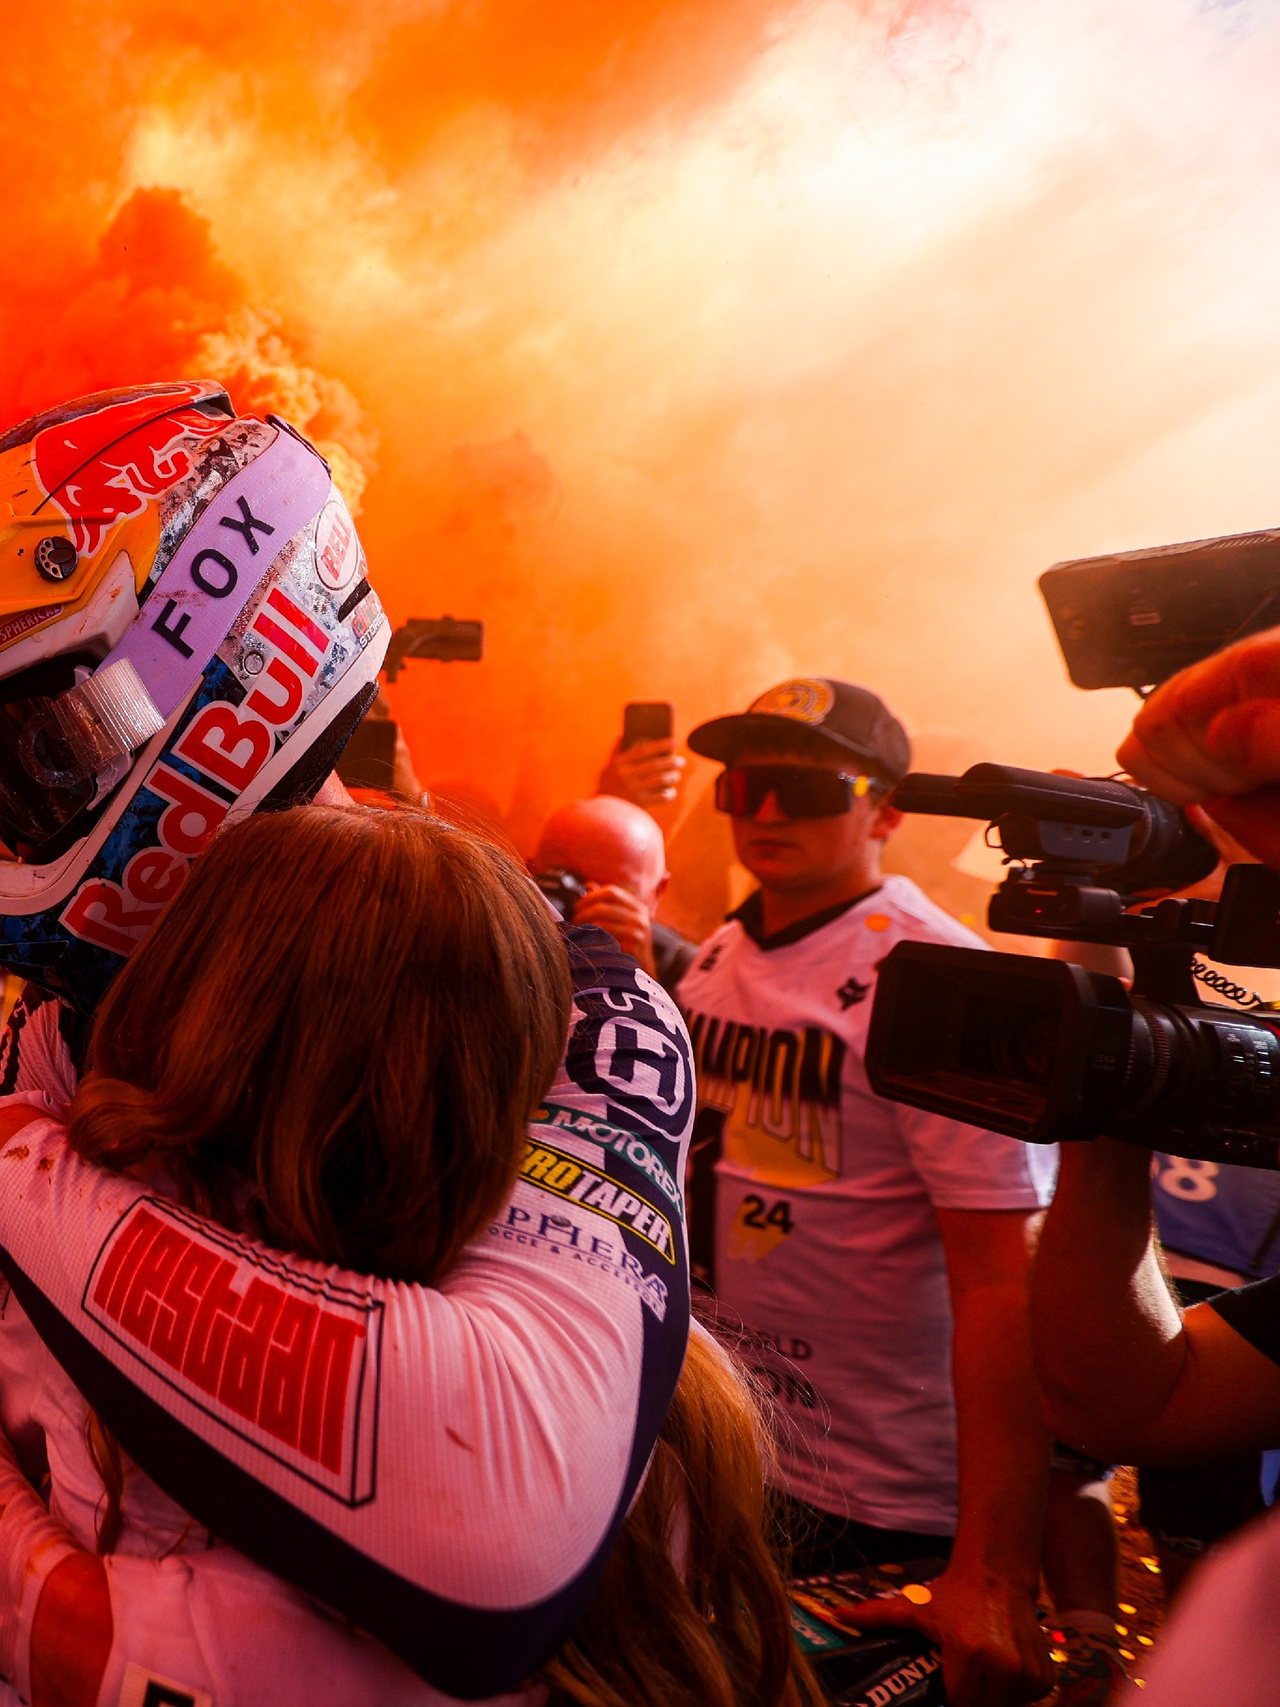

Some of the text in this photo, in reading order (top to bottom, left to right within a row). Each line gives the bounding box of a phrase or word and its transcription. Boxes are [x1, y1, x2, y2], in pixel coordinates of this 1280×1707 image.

[151, 495, 275, 659] FOX
[321, 512, 351, 581] BELL
[488, 1227, 537, 1248] OCCE
[742, 1195, 794, 1234] 24
[507, 1205, 669, 1298] PHERA
[865, 1649, 943, 1707] DUNL
